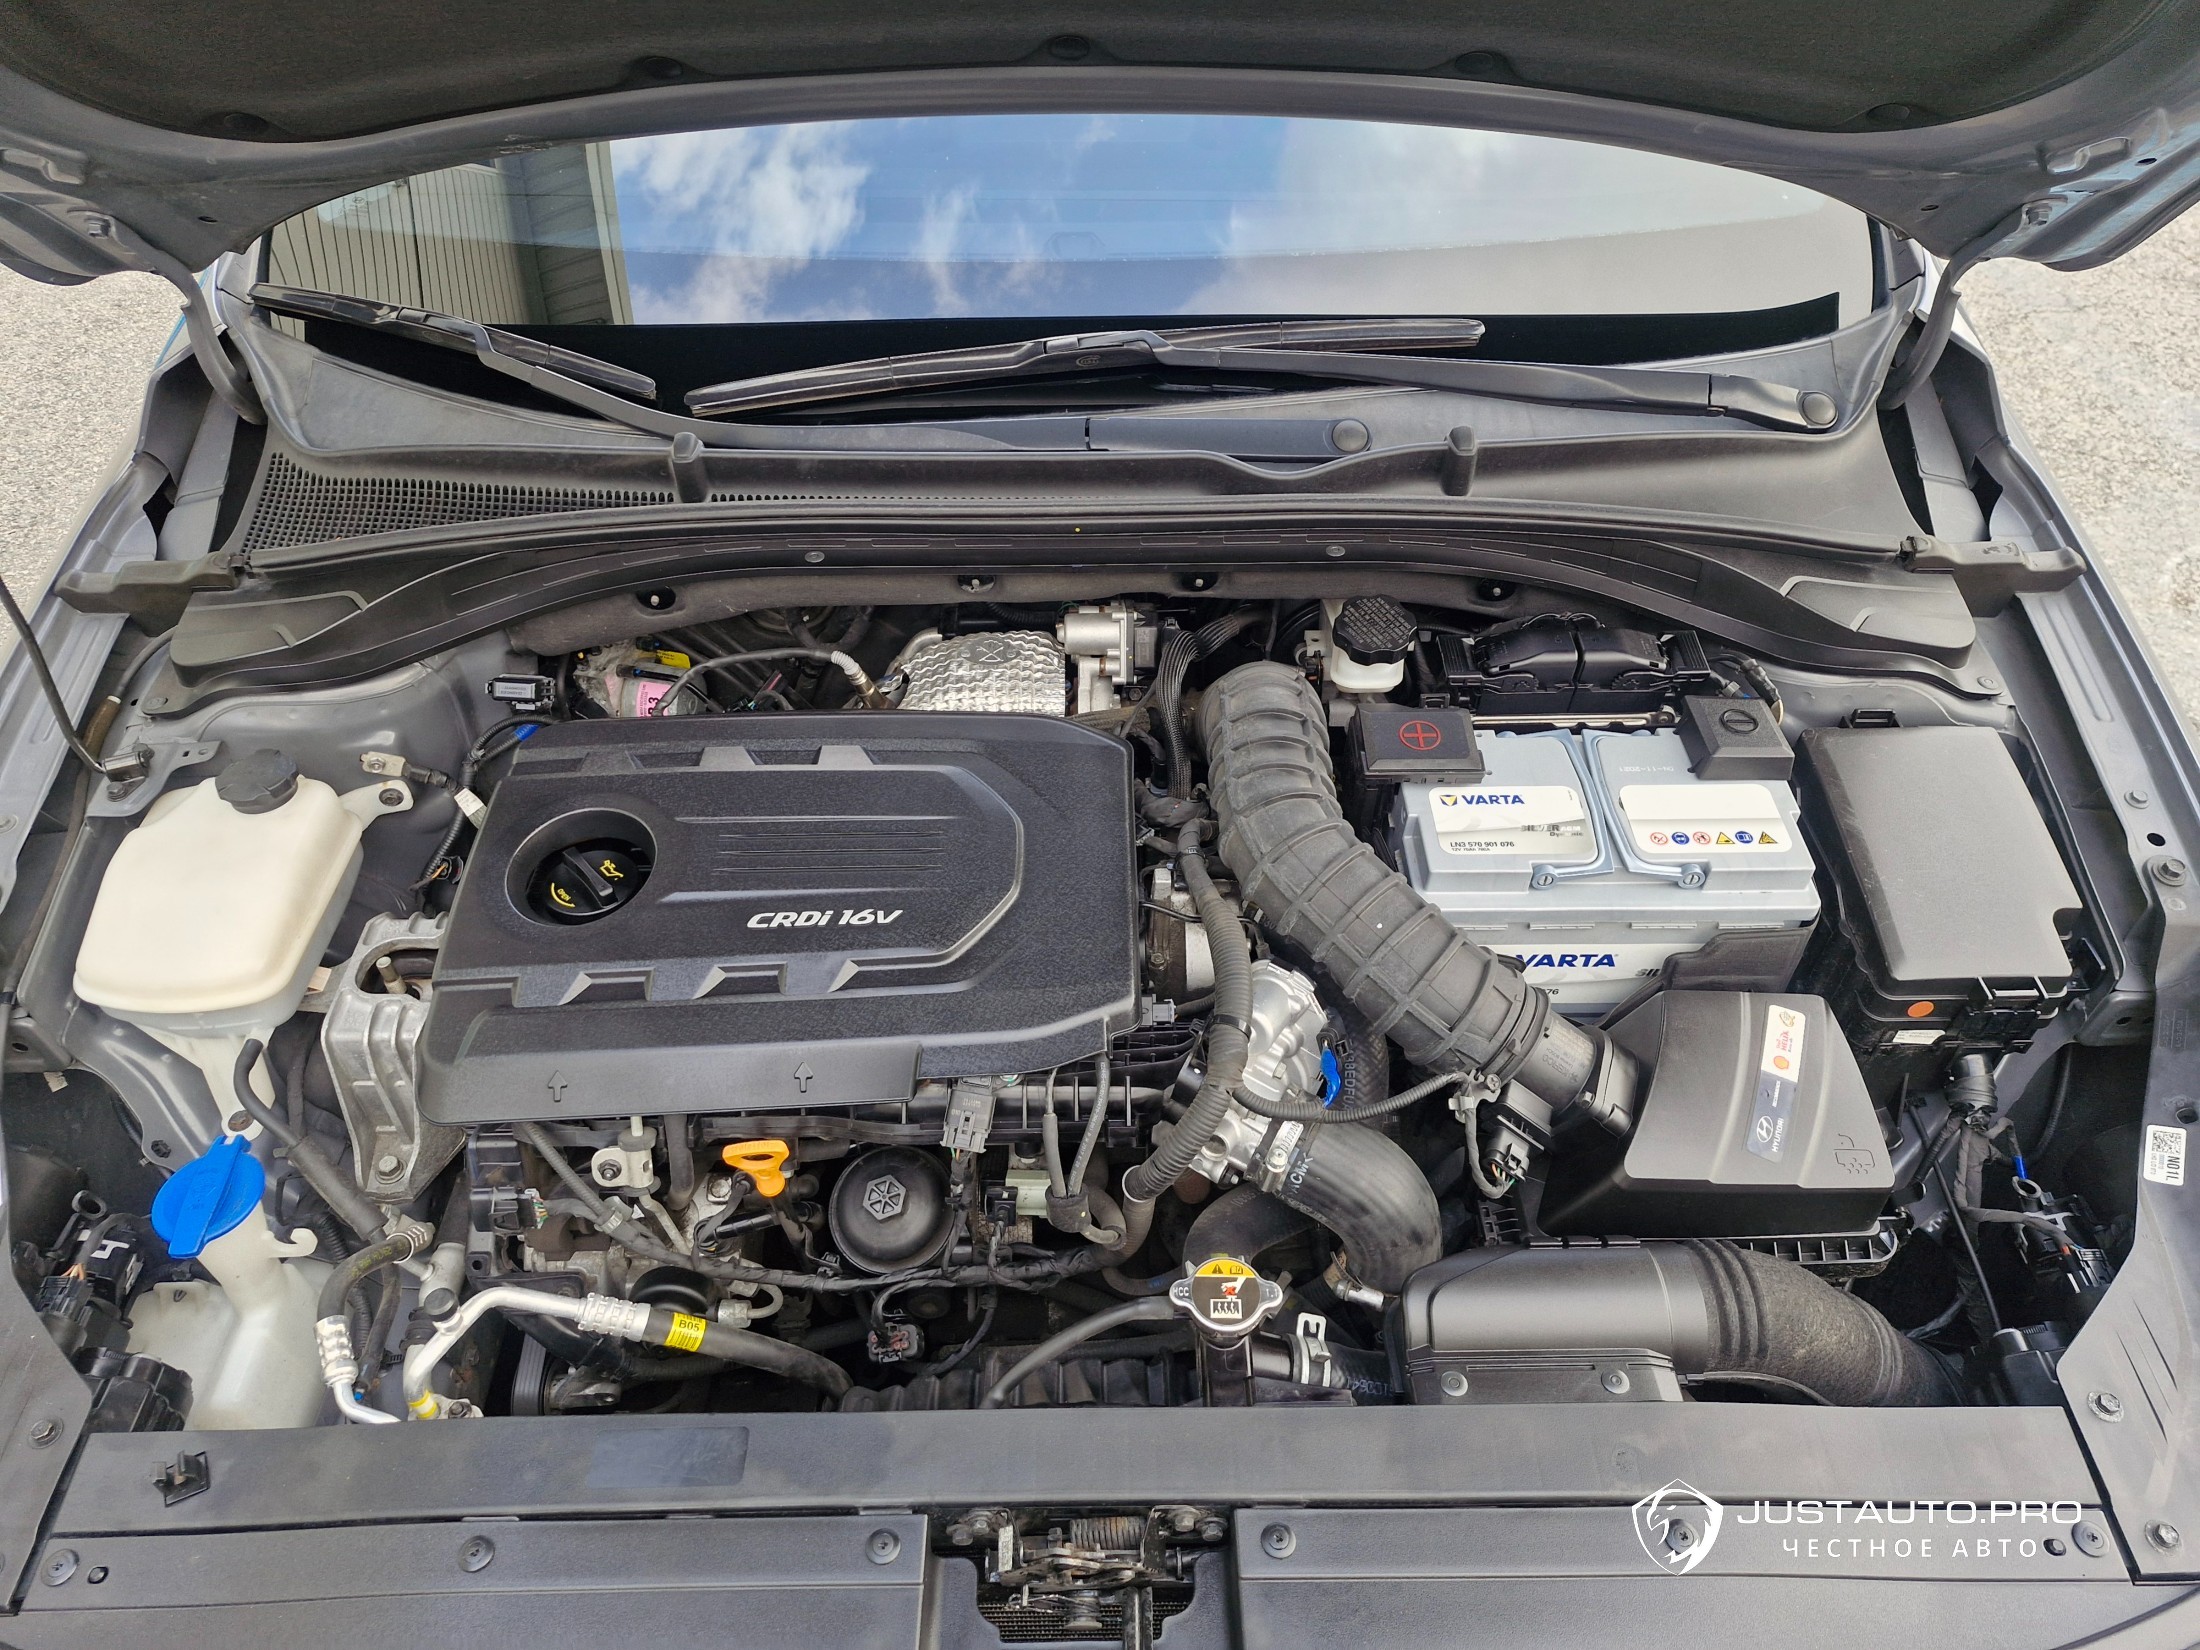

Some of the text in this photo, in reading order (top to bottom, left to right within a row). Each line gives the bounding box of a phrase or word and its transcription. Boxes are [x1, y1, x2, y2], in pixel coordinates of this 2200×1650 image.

[1461, 794, 1525, 805] VARTA
[557, 888, 571, 901] OPEN
[747, 909, 903, 928] CRDi 16V
[1516, 954, 1616, 968] VARTA
[1771, 1117, 1785, 1153] HYUNDAI
[1172, 1286, 1190, 1297] HCC
[1265, 1288, 1278, 1298] 1.1
[678, 1319, 700, 1332] B05
